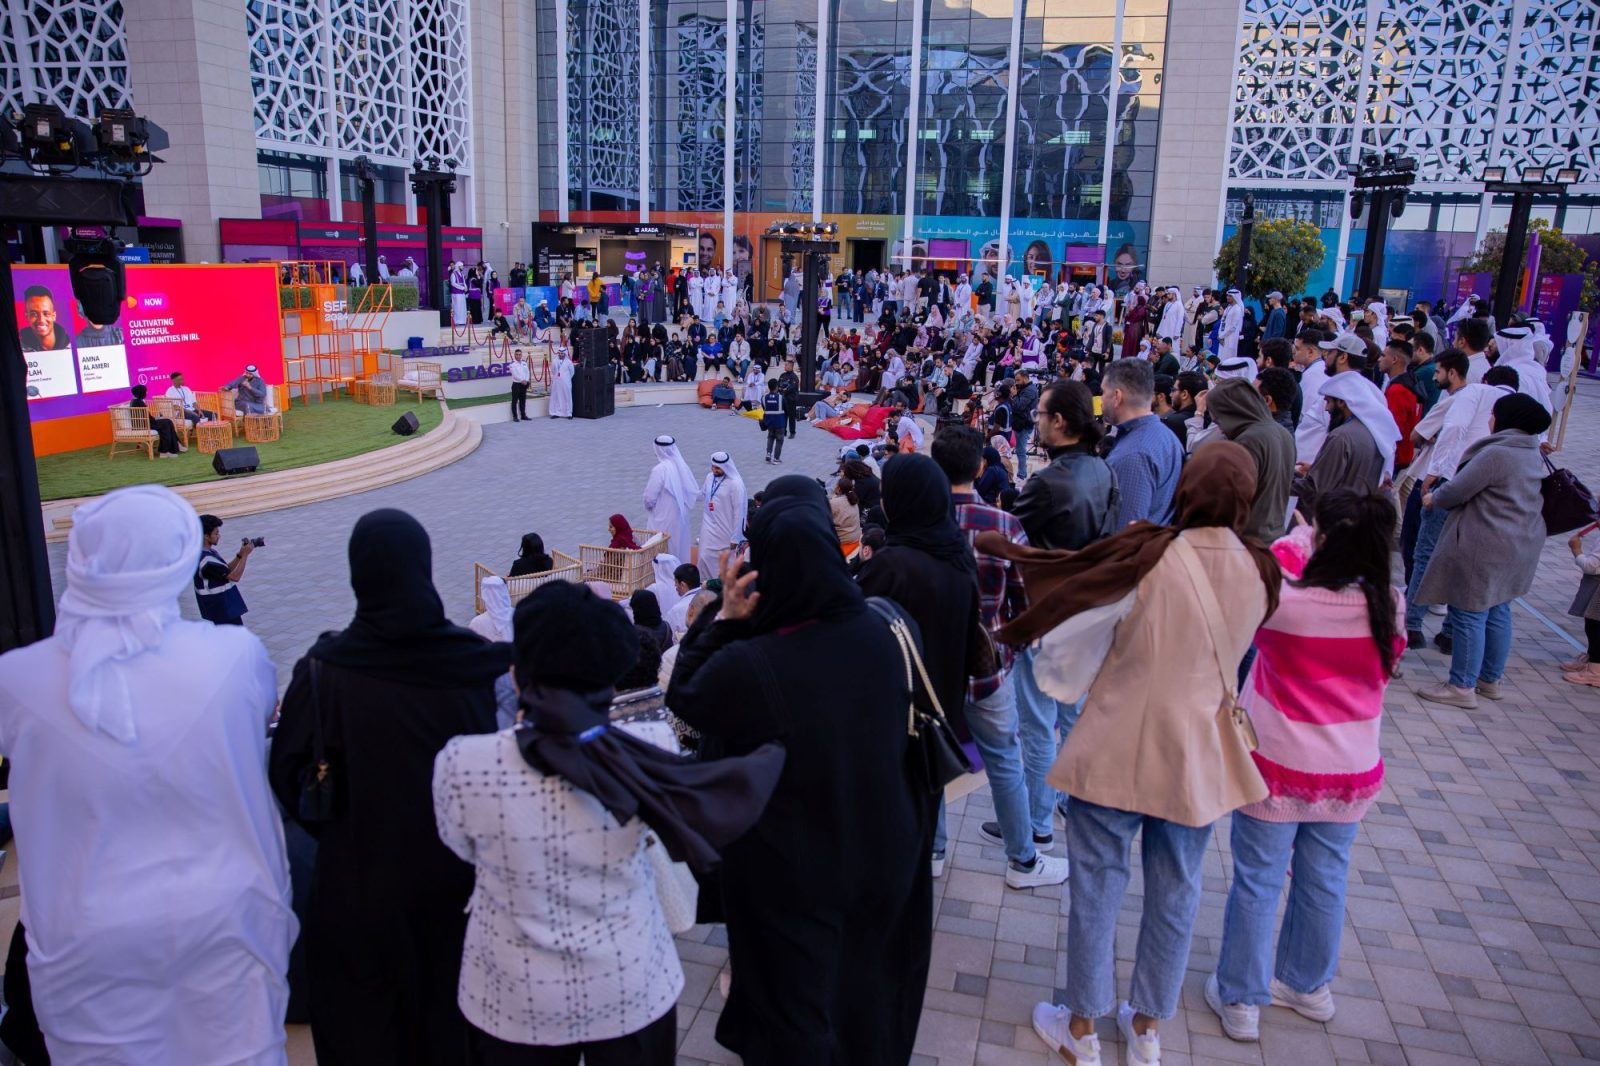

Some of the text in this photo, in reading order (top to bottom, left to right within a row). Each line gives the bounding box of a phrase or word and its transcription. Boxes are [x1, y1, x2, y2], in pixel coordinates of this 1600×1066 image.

[990, 228, 1024, 237] الأعال
[1106, 231, 1125, 239] أكب
[144, 298, 163, 306] NOW
[324, 301, 347, 312] SEF
[325, 312, 348, 322] 2024
[129, 318, 174, 328] CULTIVATING
[130, 327, 169, 337] POWERFUL
[131, 335, 180, 346] COMMUNITIES
[190, 333, 200, 341] IRL
[401, 345, 470, 358] CREATIVE
[81, 355, 100, 363] AMNA
[447, 361, 515, 383] STAGE
